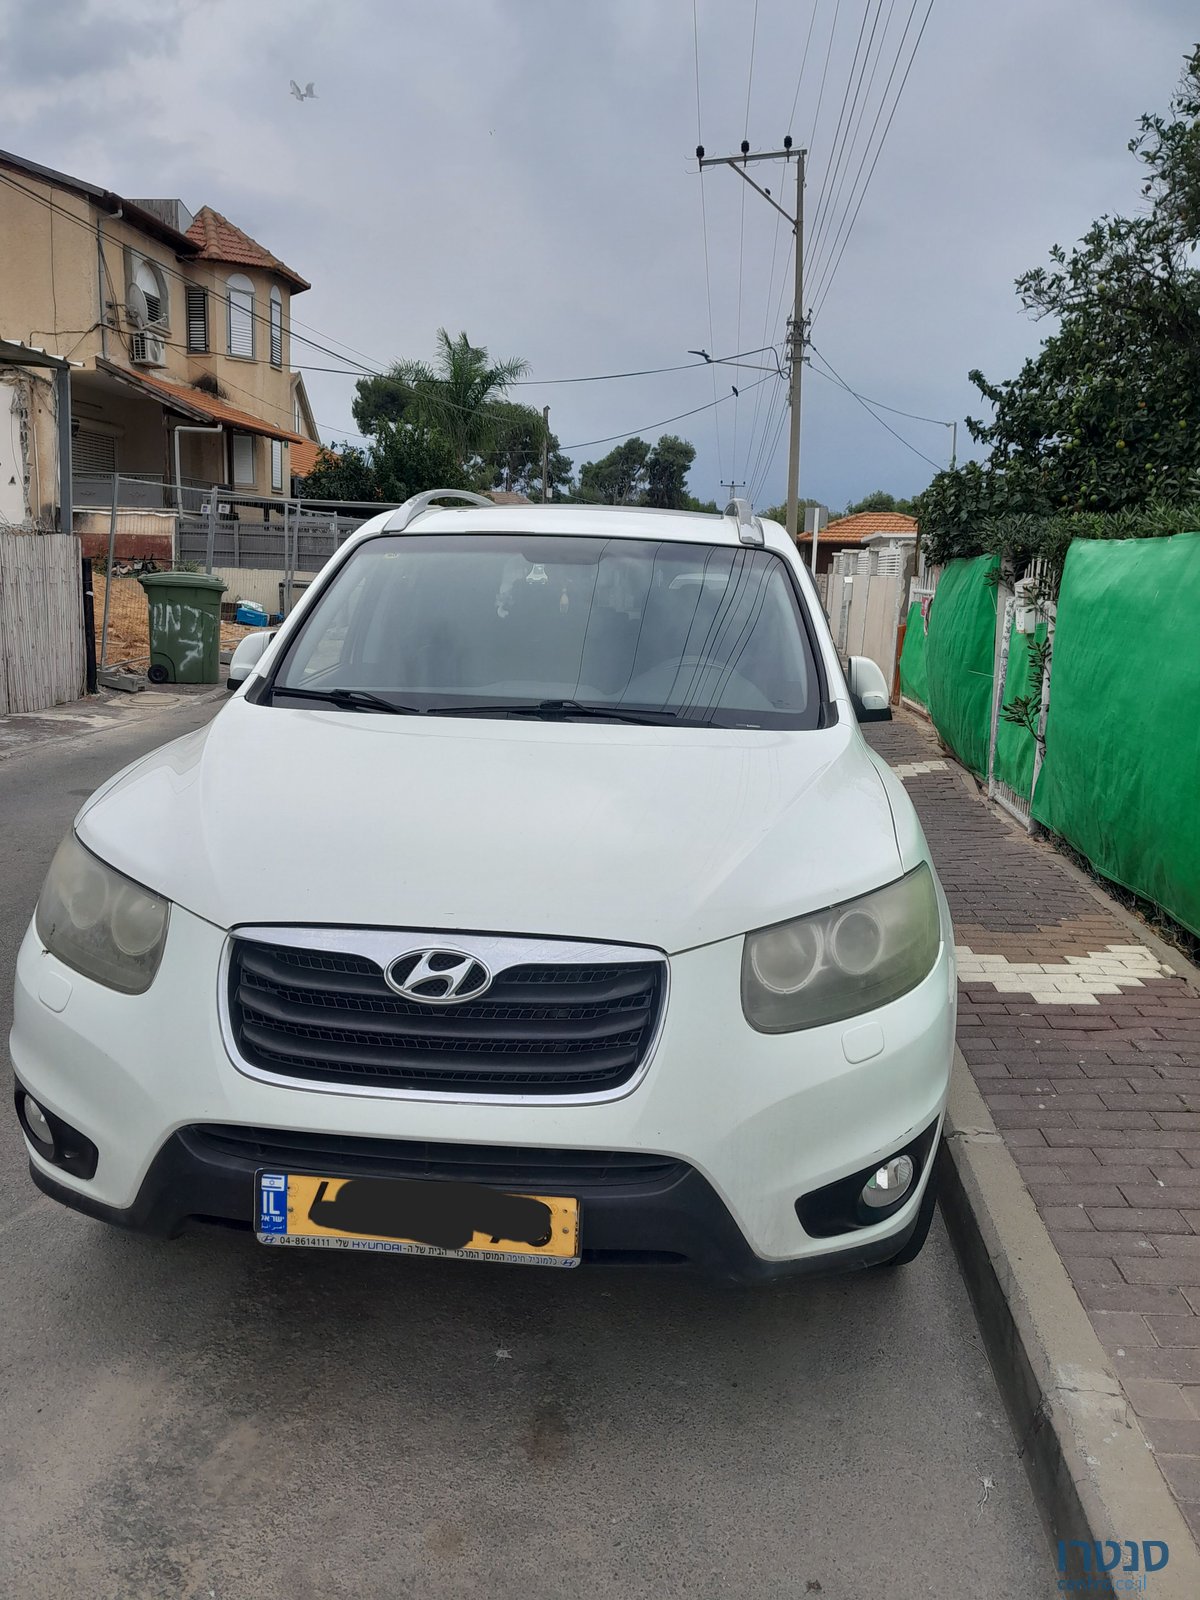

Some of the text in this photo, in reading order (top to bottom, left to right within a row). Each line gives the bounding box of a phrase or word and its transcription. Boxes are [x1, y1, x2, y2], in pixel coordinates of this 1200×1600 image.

[263, 1191, 280, 1215] IL
[280, 1236, 330, 1247] 04-8614111
[335, 1238, 349, 1248] שלי
[415, 1244, 426, 1254] של
[428, 1247, 447, 1256] הבית
[454, 1249, 480, 1259] המרכזי
[481, 1251, 505, 1262] המוסך
[506, 1254, 526, 1263] חיפה
[527, 1256, 557, 1266] כלמוביל
